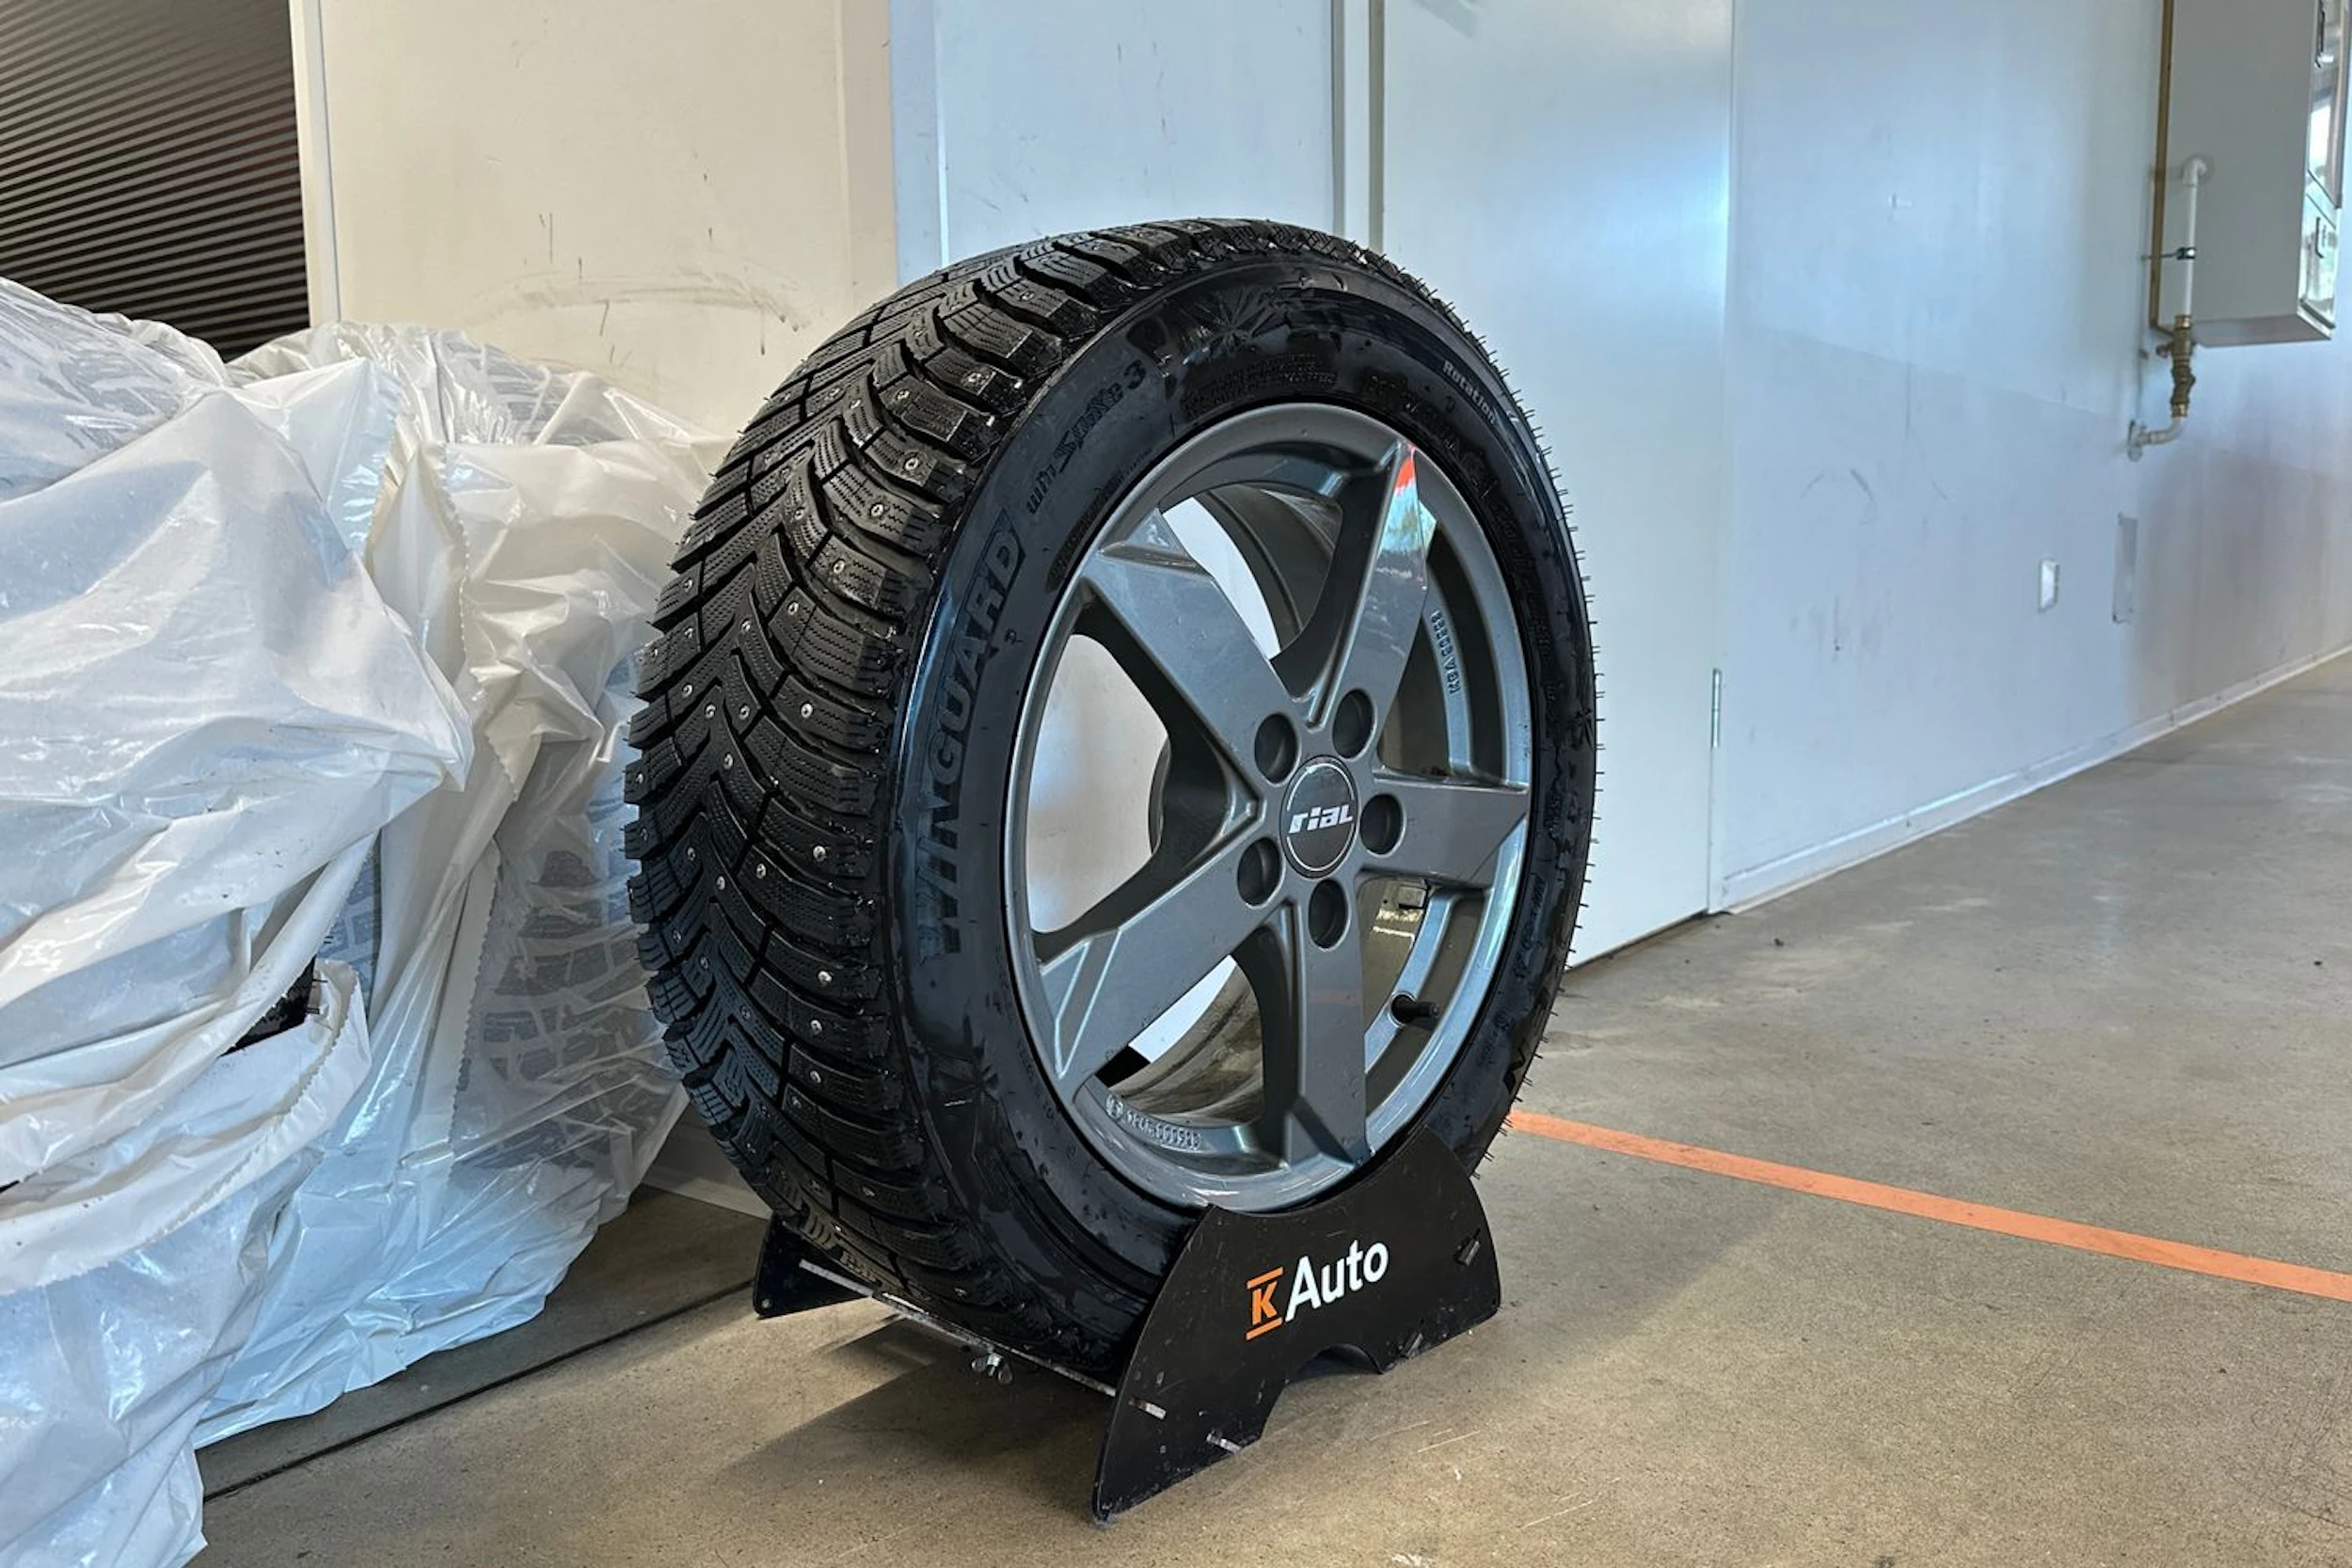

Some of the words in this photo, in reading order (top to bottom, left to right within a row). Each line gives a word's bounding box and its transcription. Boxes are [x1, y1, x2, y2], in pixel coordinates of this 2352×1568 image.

[1441, 358, 1499, 425] Rotation
[915, 528, 1022, 959] WINGUARD
[1288, 803, 1354, 834] rial
[1285, 1240, 1389, 1322] Auto
